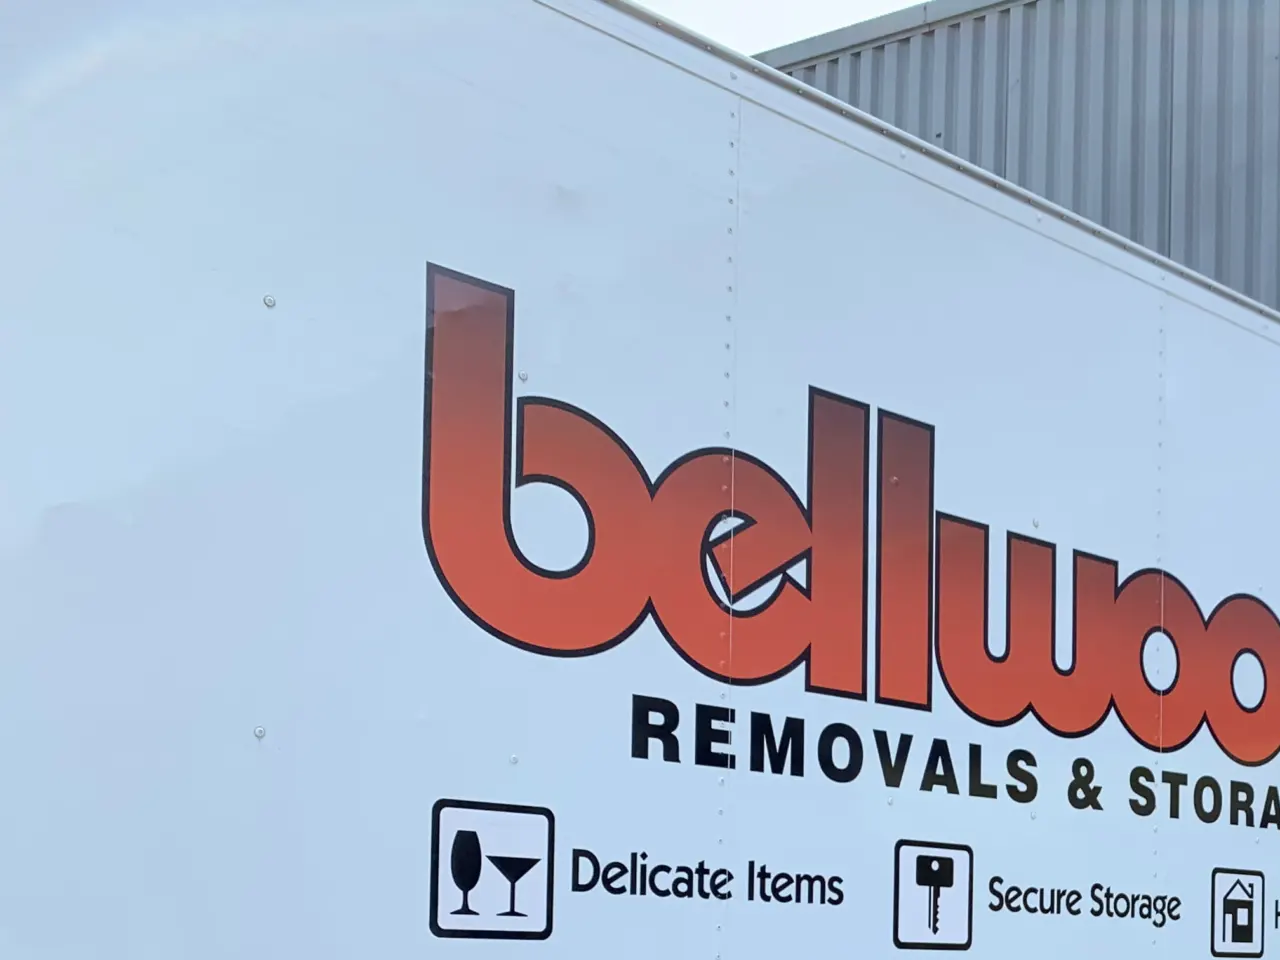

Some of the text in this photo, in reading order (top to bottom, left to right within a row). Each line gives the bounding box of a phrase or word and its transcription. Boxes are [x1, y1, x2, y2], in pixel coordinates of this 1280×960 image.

[631, 693, 1038, 804] REMOVALS
[1067, 757, 1104, 811] &
[571, 848, 844, 906] Delicate Items
[988, 876, 1182, 928] Secure Storage
